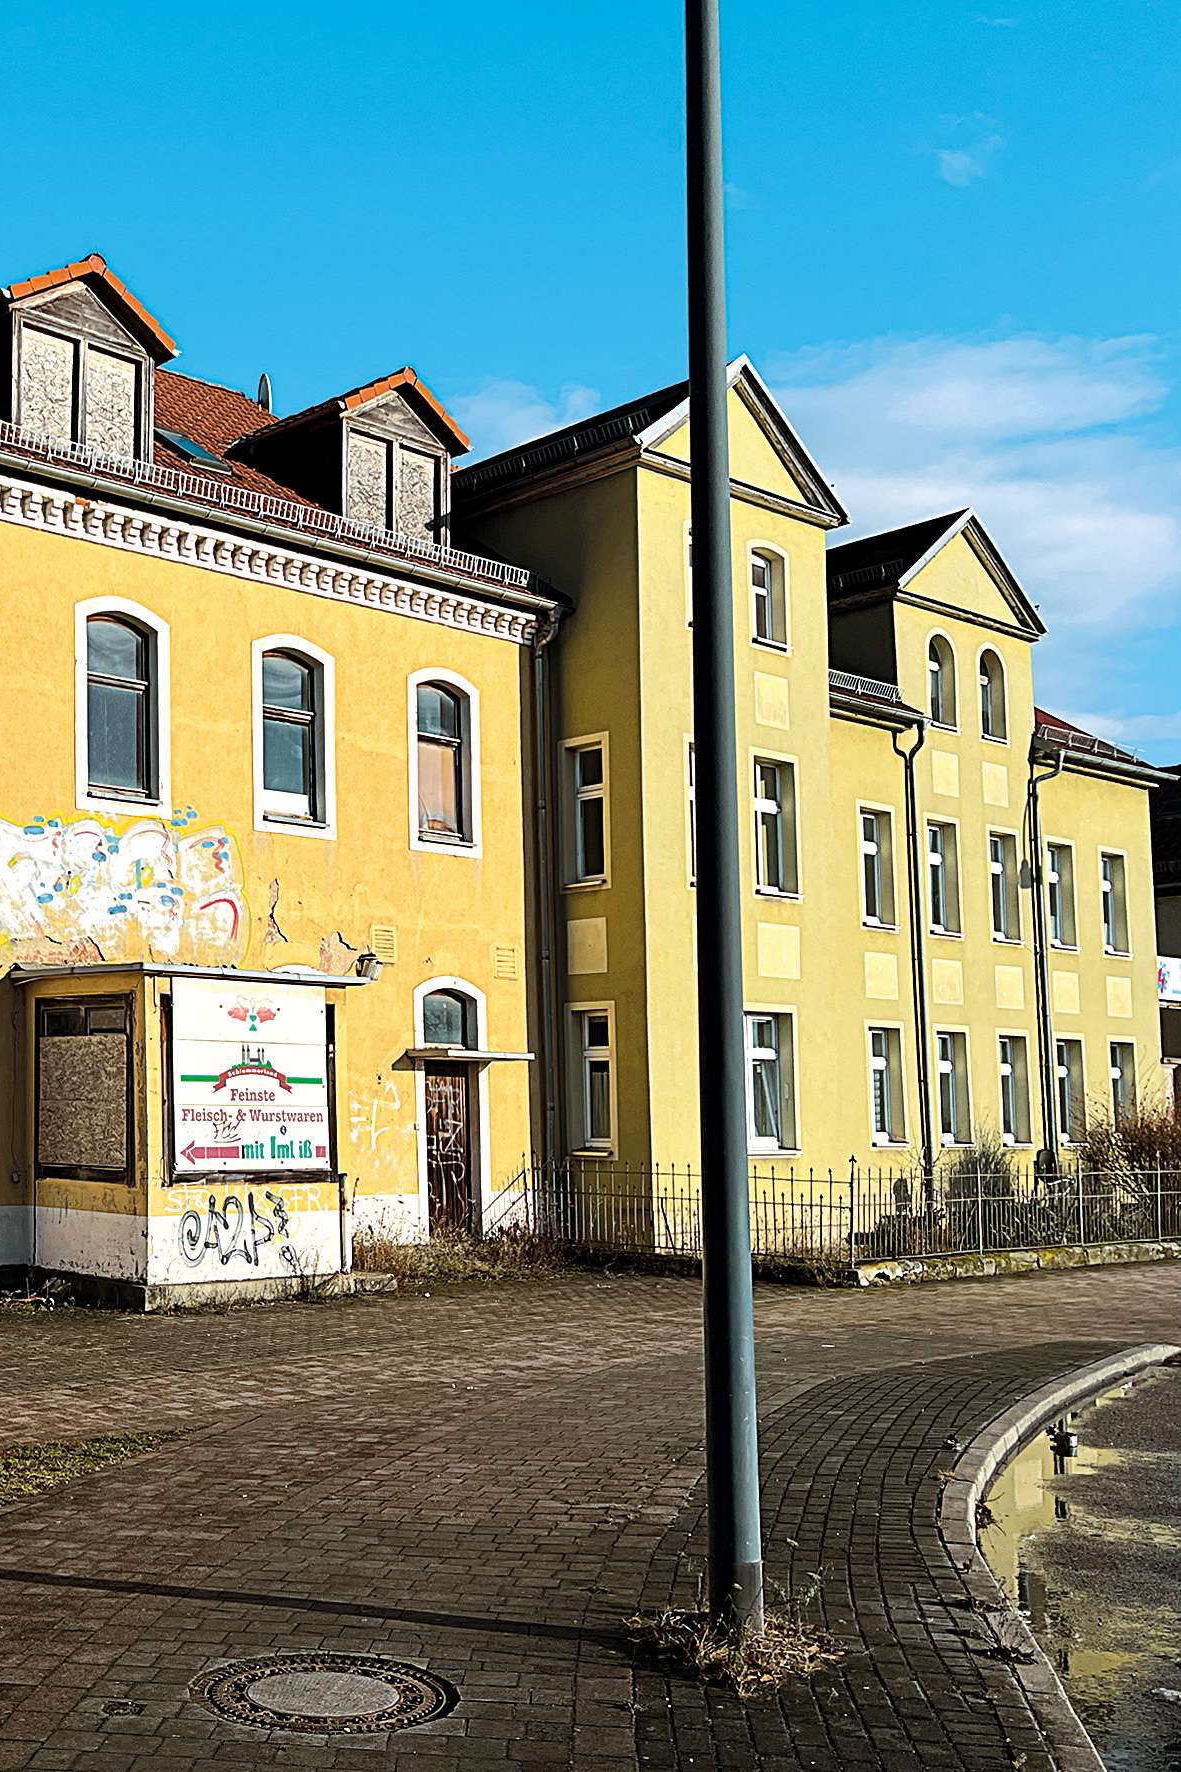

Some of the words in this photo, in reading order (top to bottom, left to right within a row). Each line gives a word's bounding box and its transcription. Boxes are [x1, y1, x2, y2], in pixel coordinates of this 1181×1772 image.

[230, 1088, 276, 1102] Feinste
[181, 1108, 233, 1122] Fleisch-
[236, 1109, 246, 1121] &
[249, 1109, 324, 1122] Wurstwaren
[241, 1140, 265, 1159] mit
